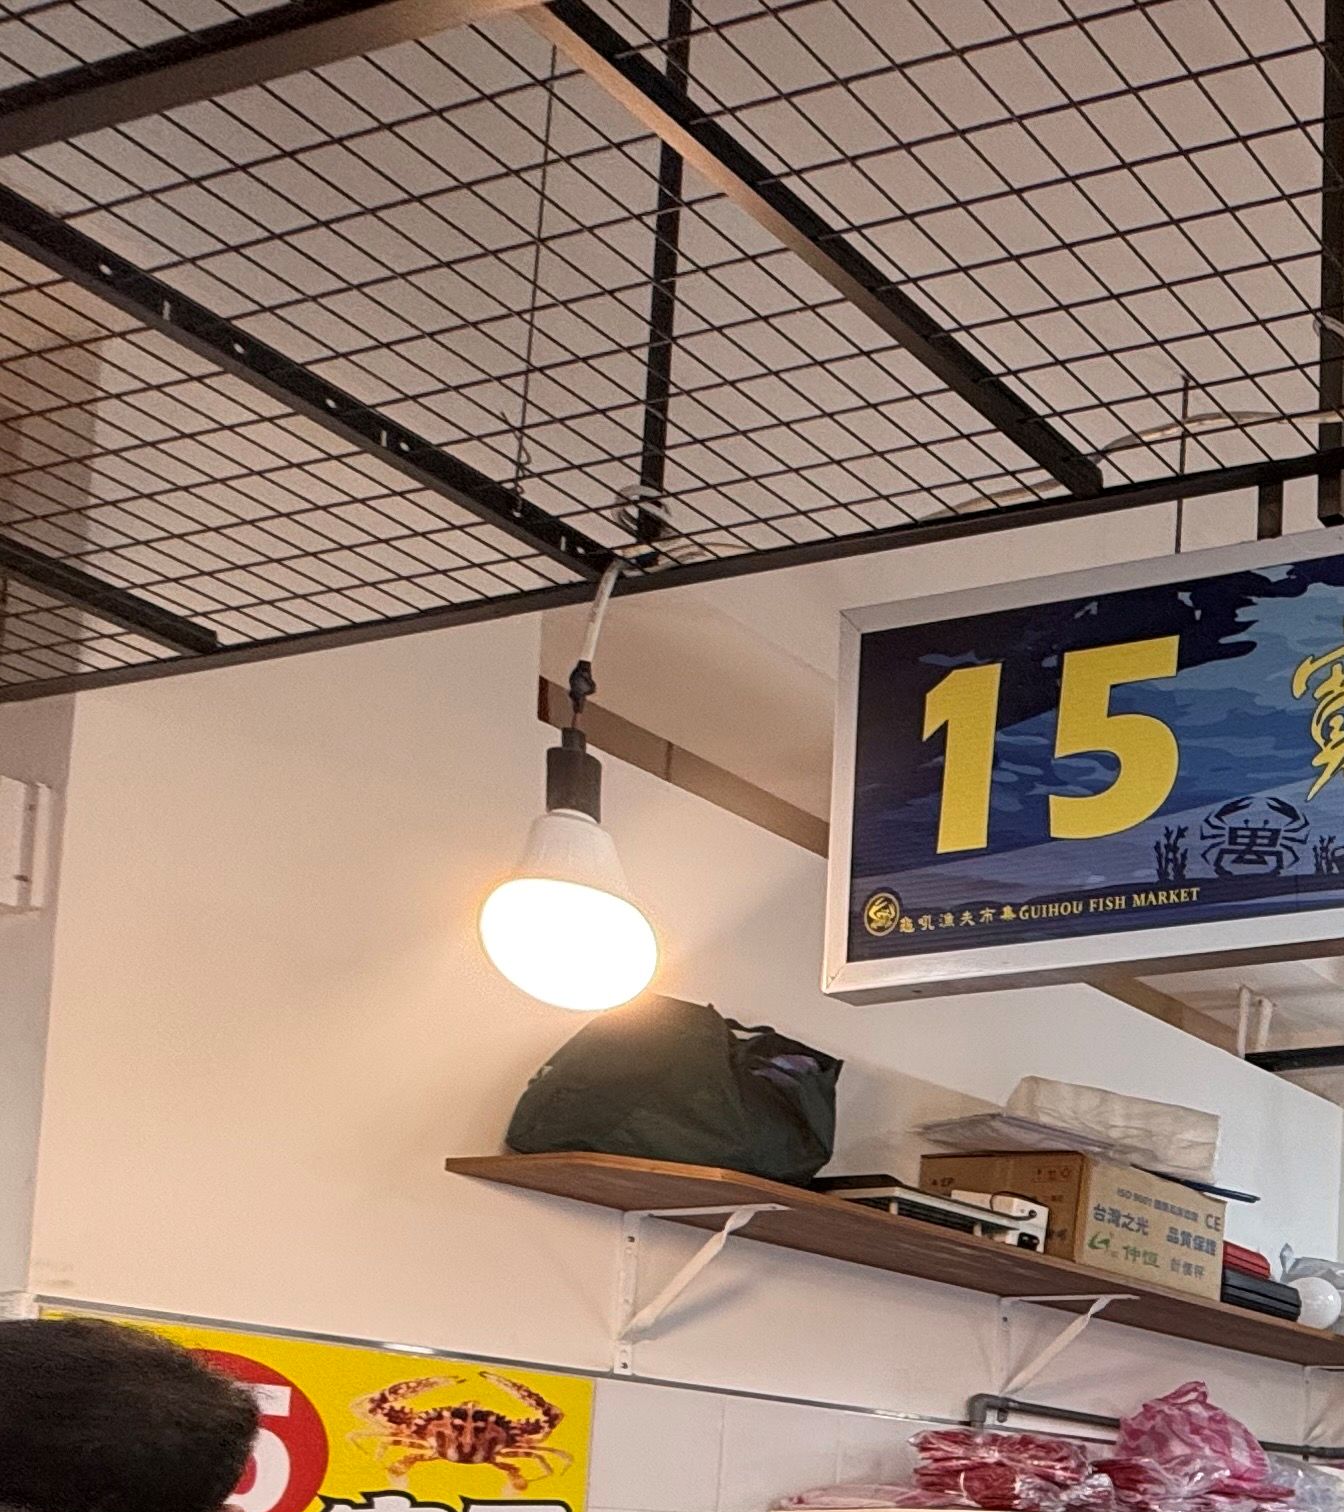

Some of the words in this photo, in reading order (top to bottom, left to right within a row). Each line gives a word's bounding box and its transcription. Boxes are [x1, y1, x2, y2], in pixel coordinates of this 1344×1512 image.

[921, 634, 1181, 856] 15
[1018, 900, 1084, 921] GUIHOU
[1089, 895, 1127, 913] FISH
[1132, 887, 1201, 908] MARKET
